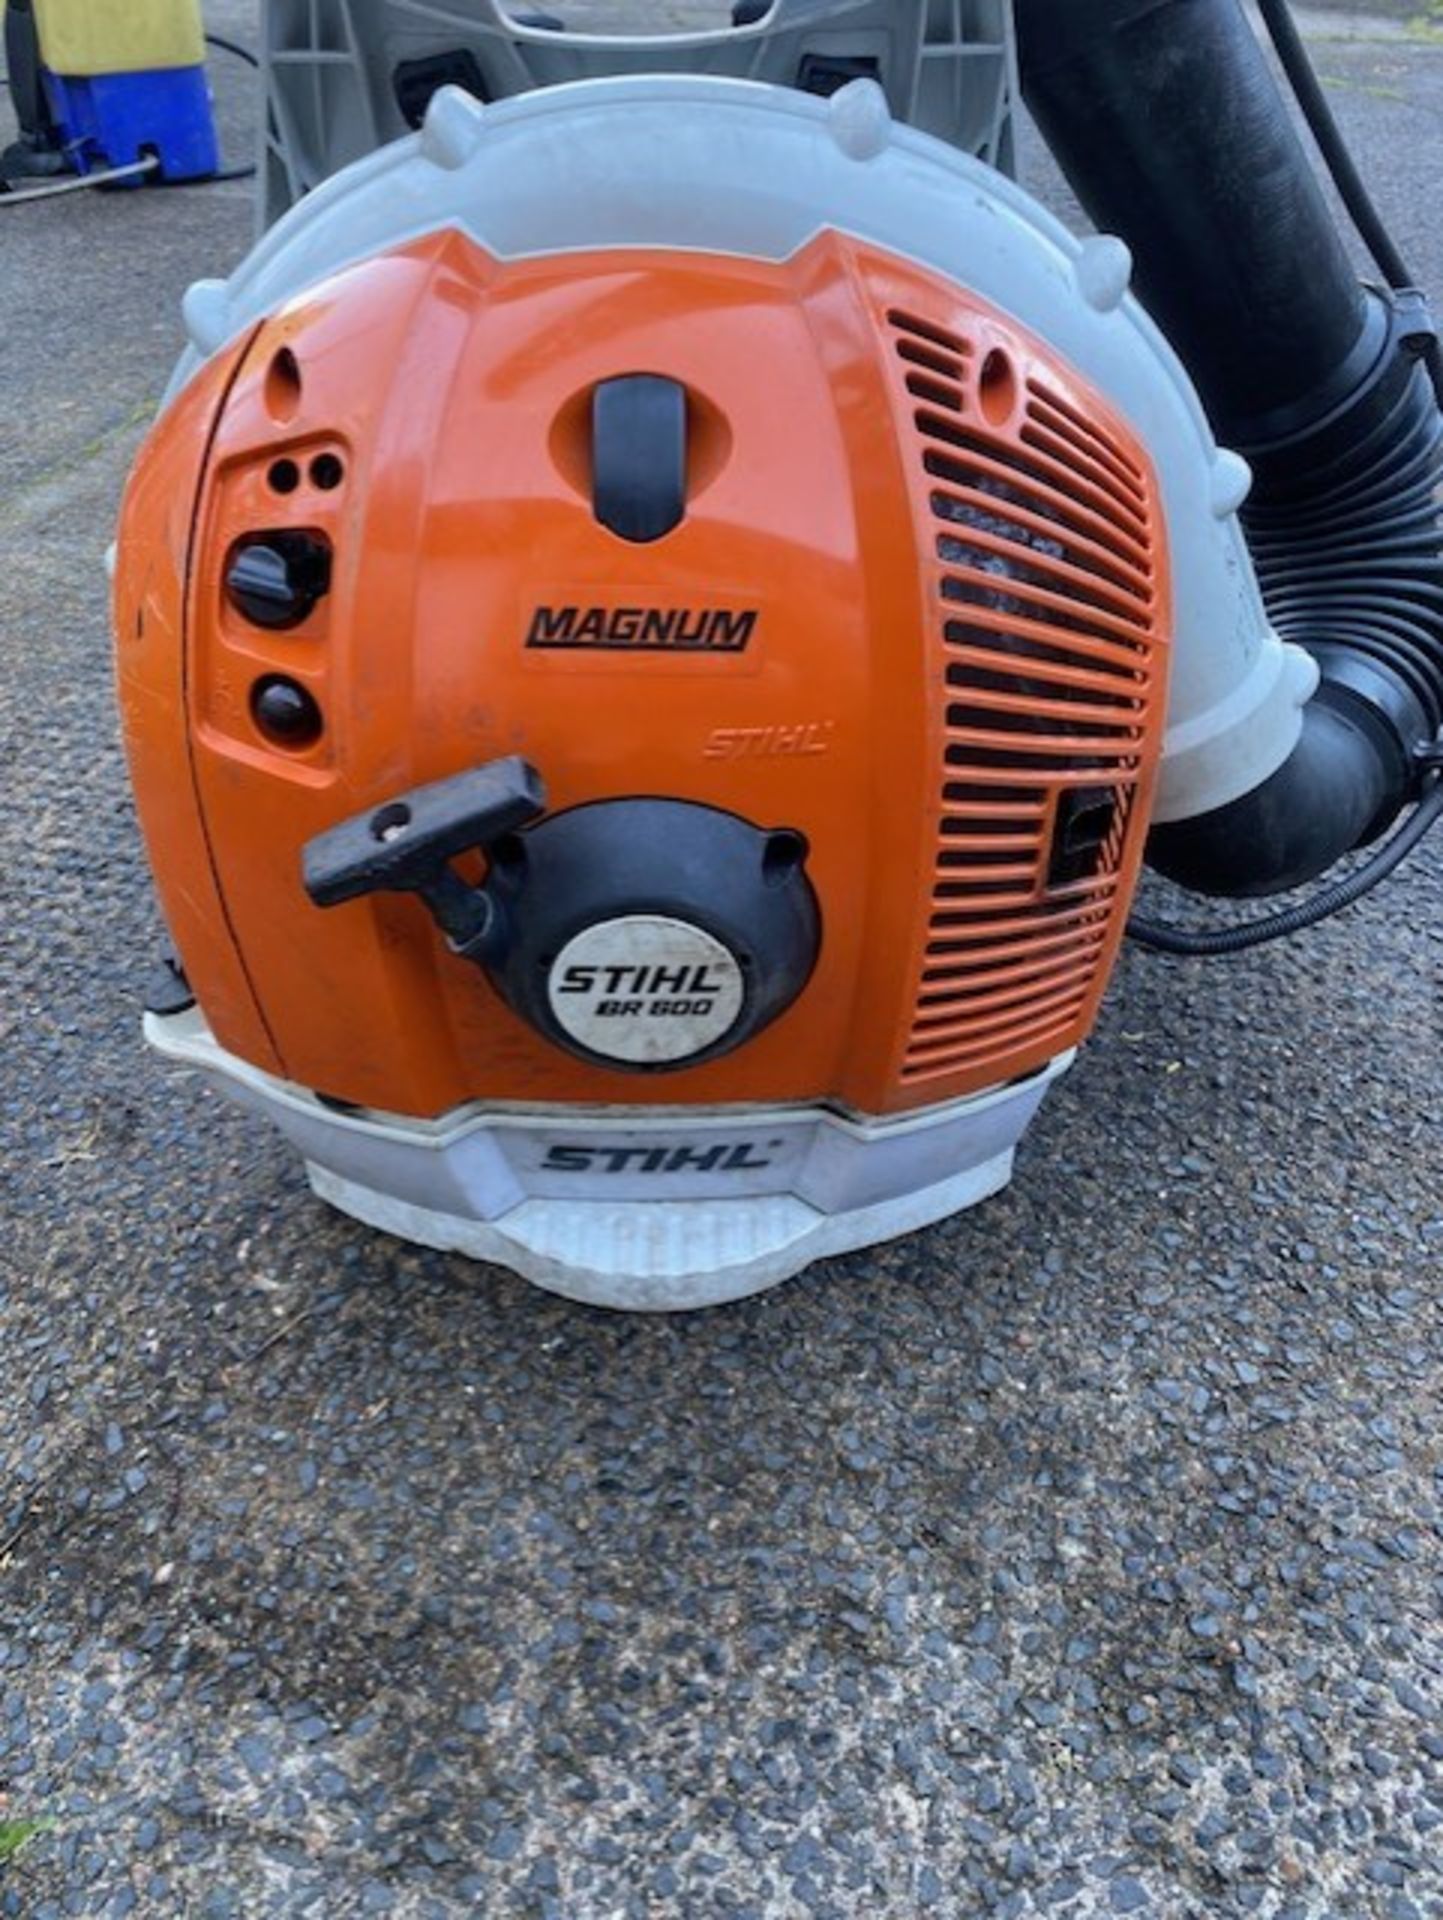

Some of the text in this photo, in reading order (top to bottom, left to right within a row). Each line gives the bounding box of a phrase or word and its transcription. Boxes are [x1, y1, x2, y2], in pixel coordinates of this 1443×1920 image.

[524, 605, 759, 653] MAGNUM
[703, 723, 829, 759] STIHL
[558, 965, 722, 994] STIHL
[540, 1142, 769, 1173] STIHL
